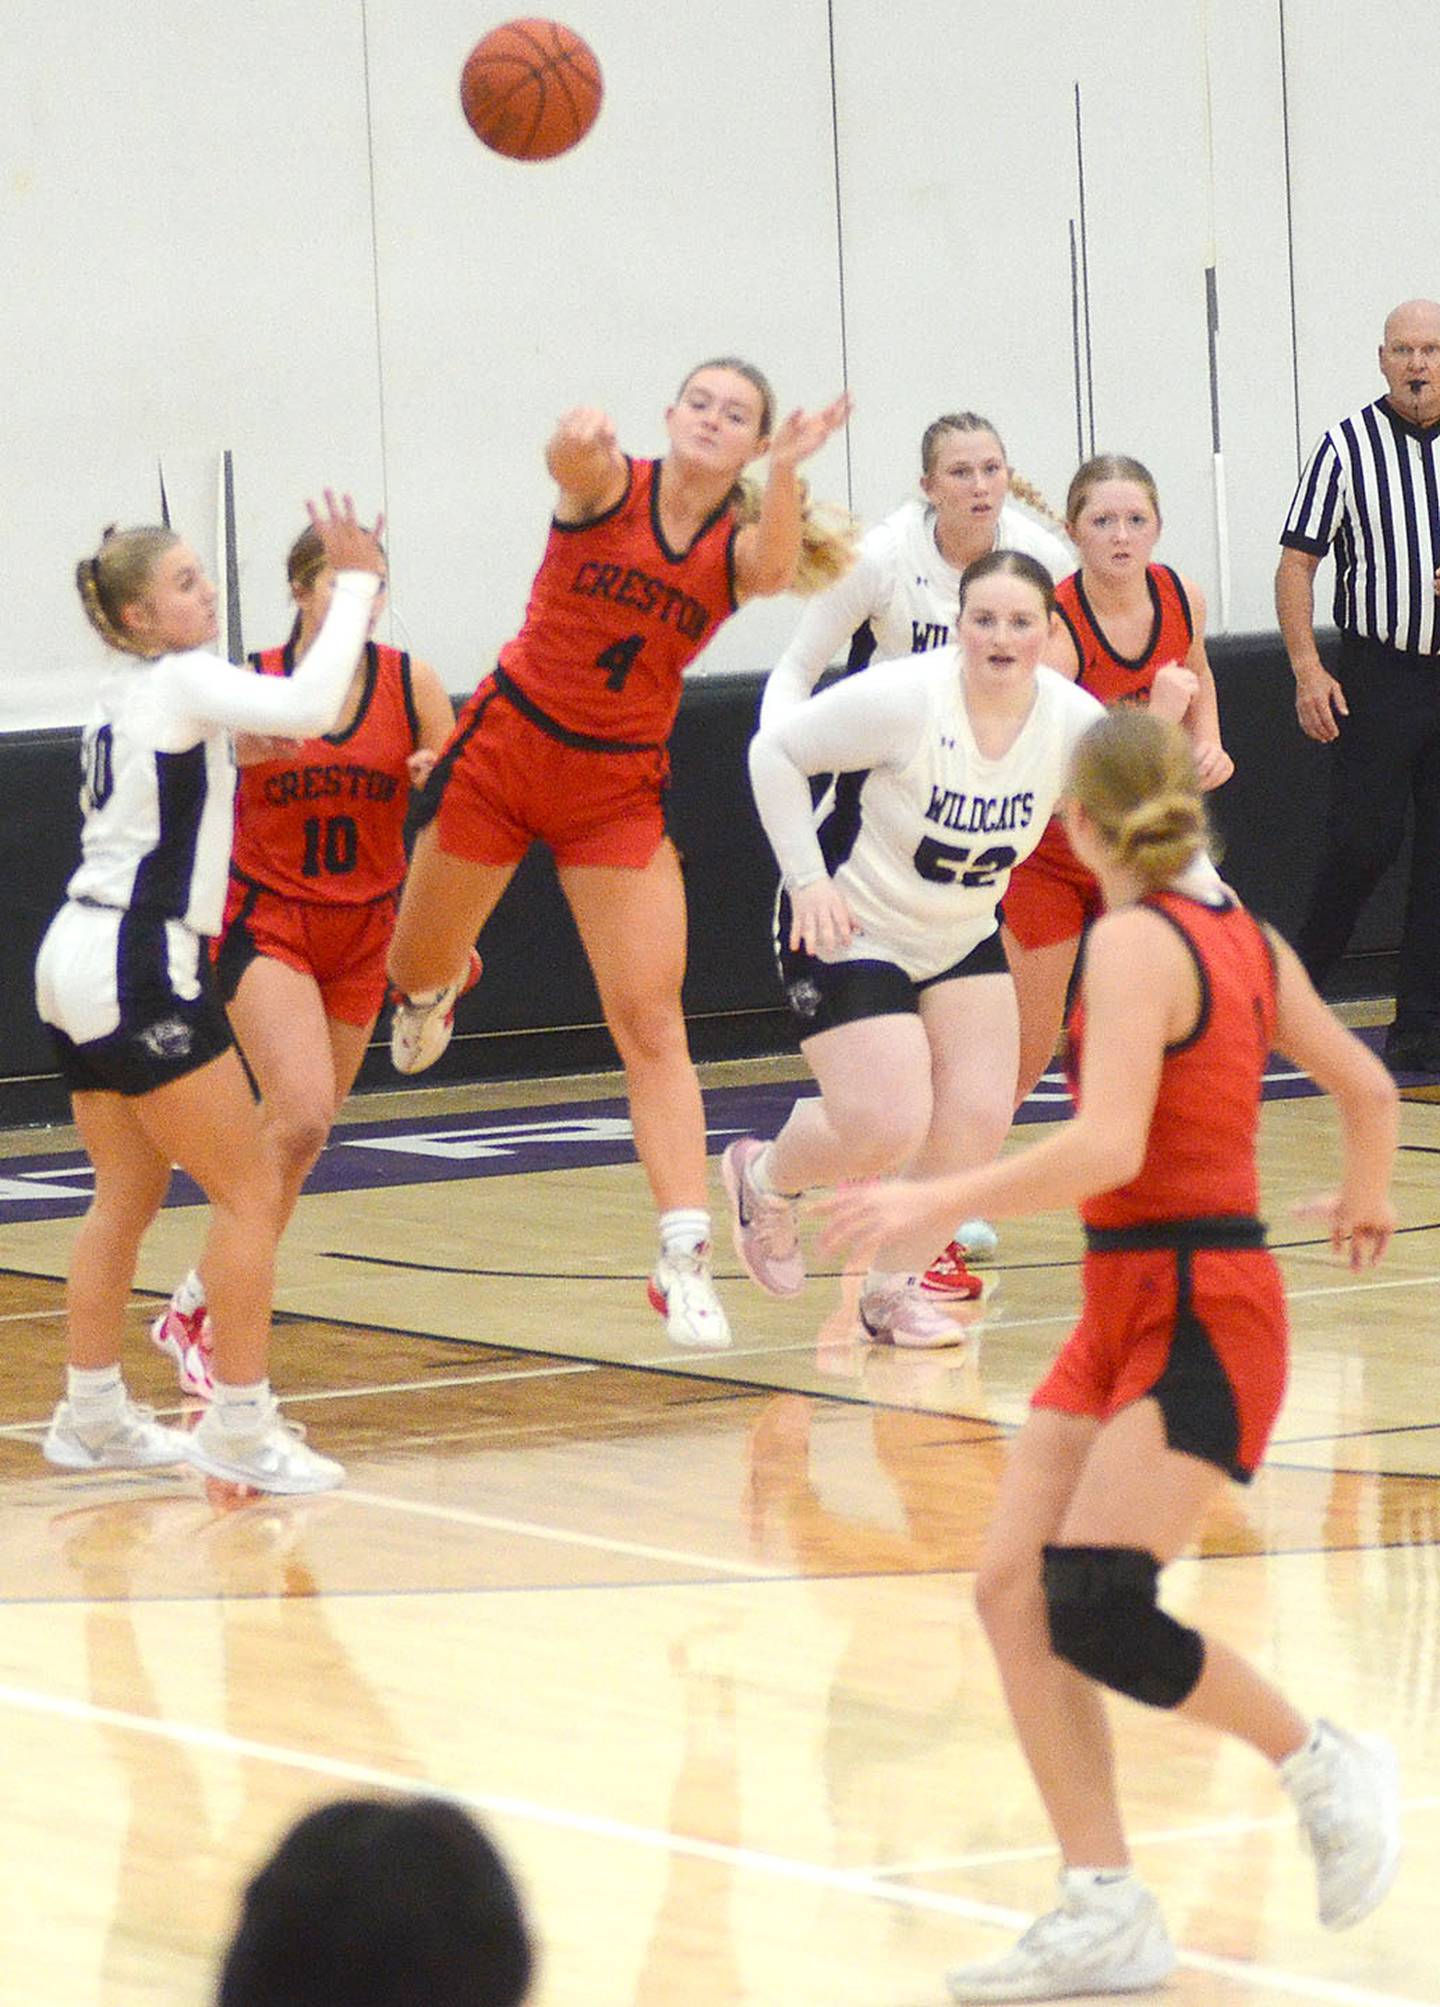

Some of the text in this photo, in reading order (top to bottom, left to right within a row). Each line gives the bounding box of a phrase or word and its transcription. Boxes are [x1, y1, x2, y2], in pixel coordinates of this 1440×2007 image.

[573, 561, 710, 642] CRESTON
[596, 634, 646, 692] 4
[263, 764, 398, 805] CRESTON
[924, 784, 1034, 833] WILDCATS
[302, 815, 358, 878] 10
